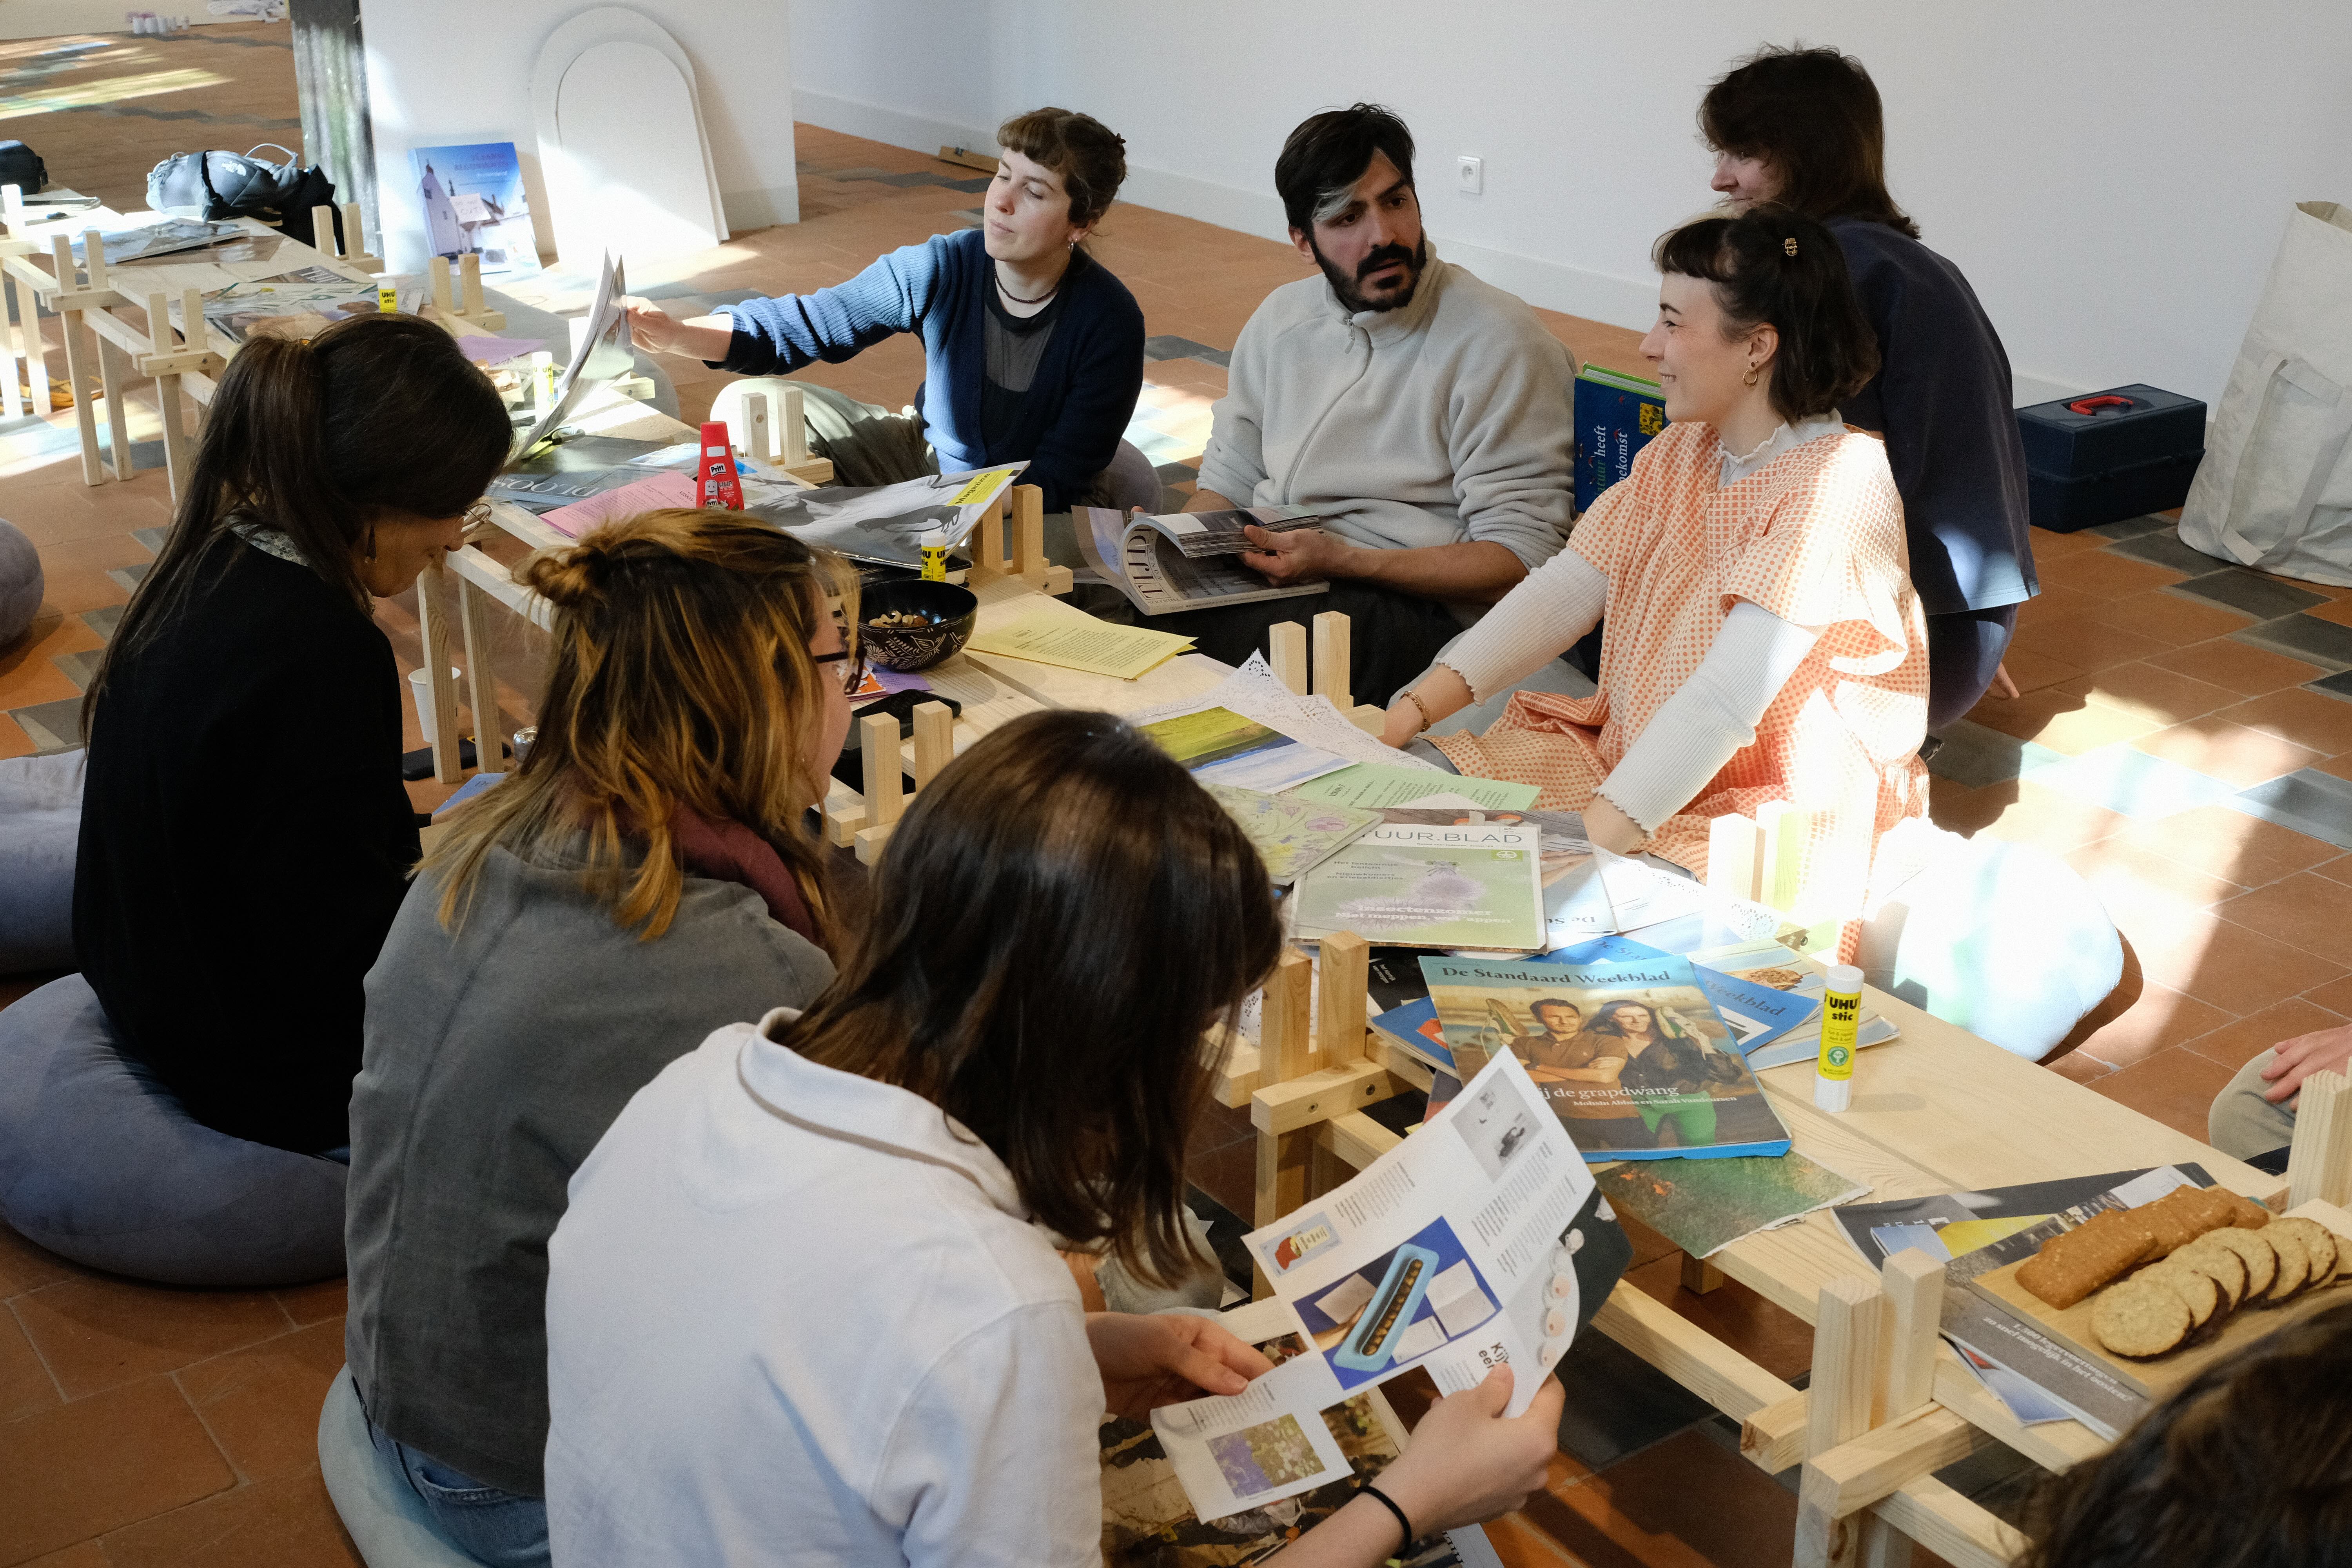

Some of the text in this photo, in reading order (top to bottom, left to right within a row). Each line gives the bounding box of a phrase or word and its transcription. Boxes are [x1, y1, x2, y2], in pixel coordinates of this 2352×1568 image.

[1593, 425, 1606, 457] heeft
[1615, 431, 1628, 486] oekomst
[711, 465, 724, 473] Pritt
[954, 473, 991, 504] Magazine
[1149, 549, 1162, 581] WONEN
[1328, 787, 1341, 796] VISION
[1363, 830, 1522, 843] UUR.BLAD
[1357, 905, 1493, 915] Insectenzomer
[1442, 967, 1670, 984] De Standaard Weekblad
[1829, 996, 1857, 1010] UHU
[1832, 1011, 1853, 1021] stic
[1553, 1088, 1575, 1097] de
[1579, 1085, 1679, 1099] grapdwang
[1983, 1317, 1997, 1325] zo
[1996, 1324, 2019, 1337] snel
[2016, 1335, 2061, 1361] mogelijk
[2061, 1358, 2073, 1368] in
[2072, 1365, 2091, 1378] het
